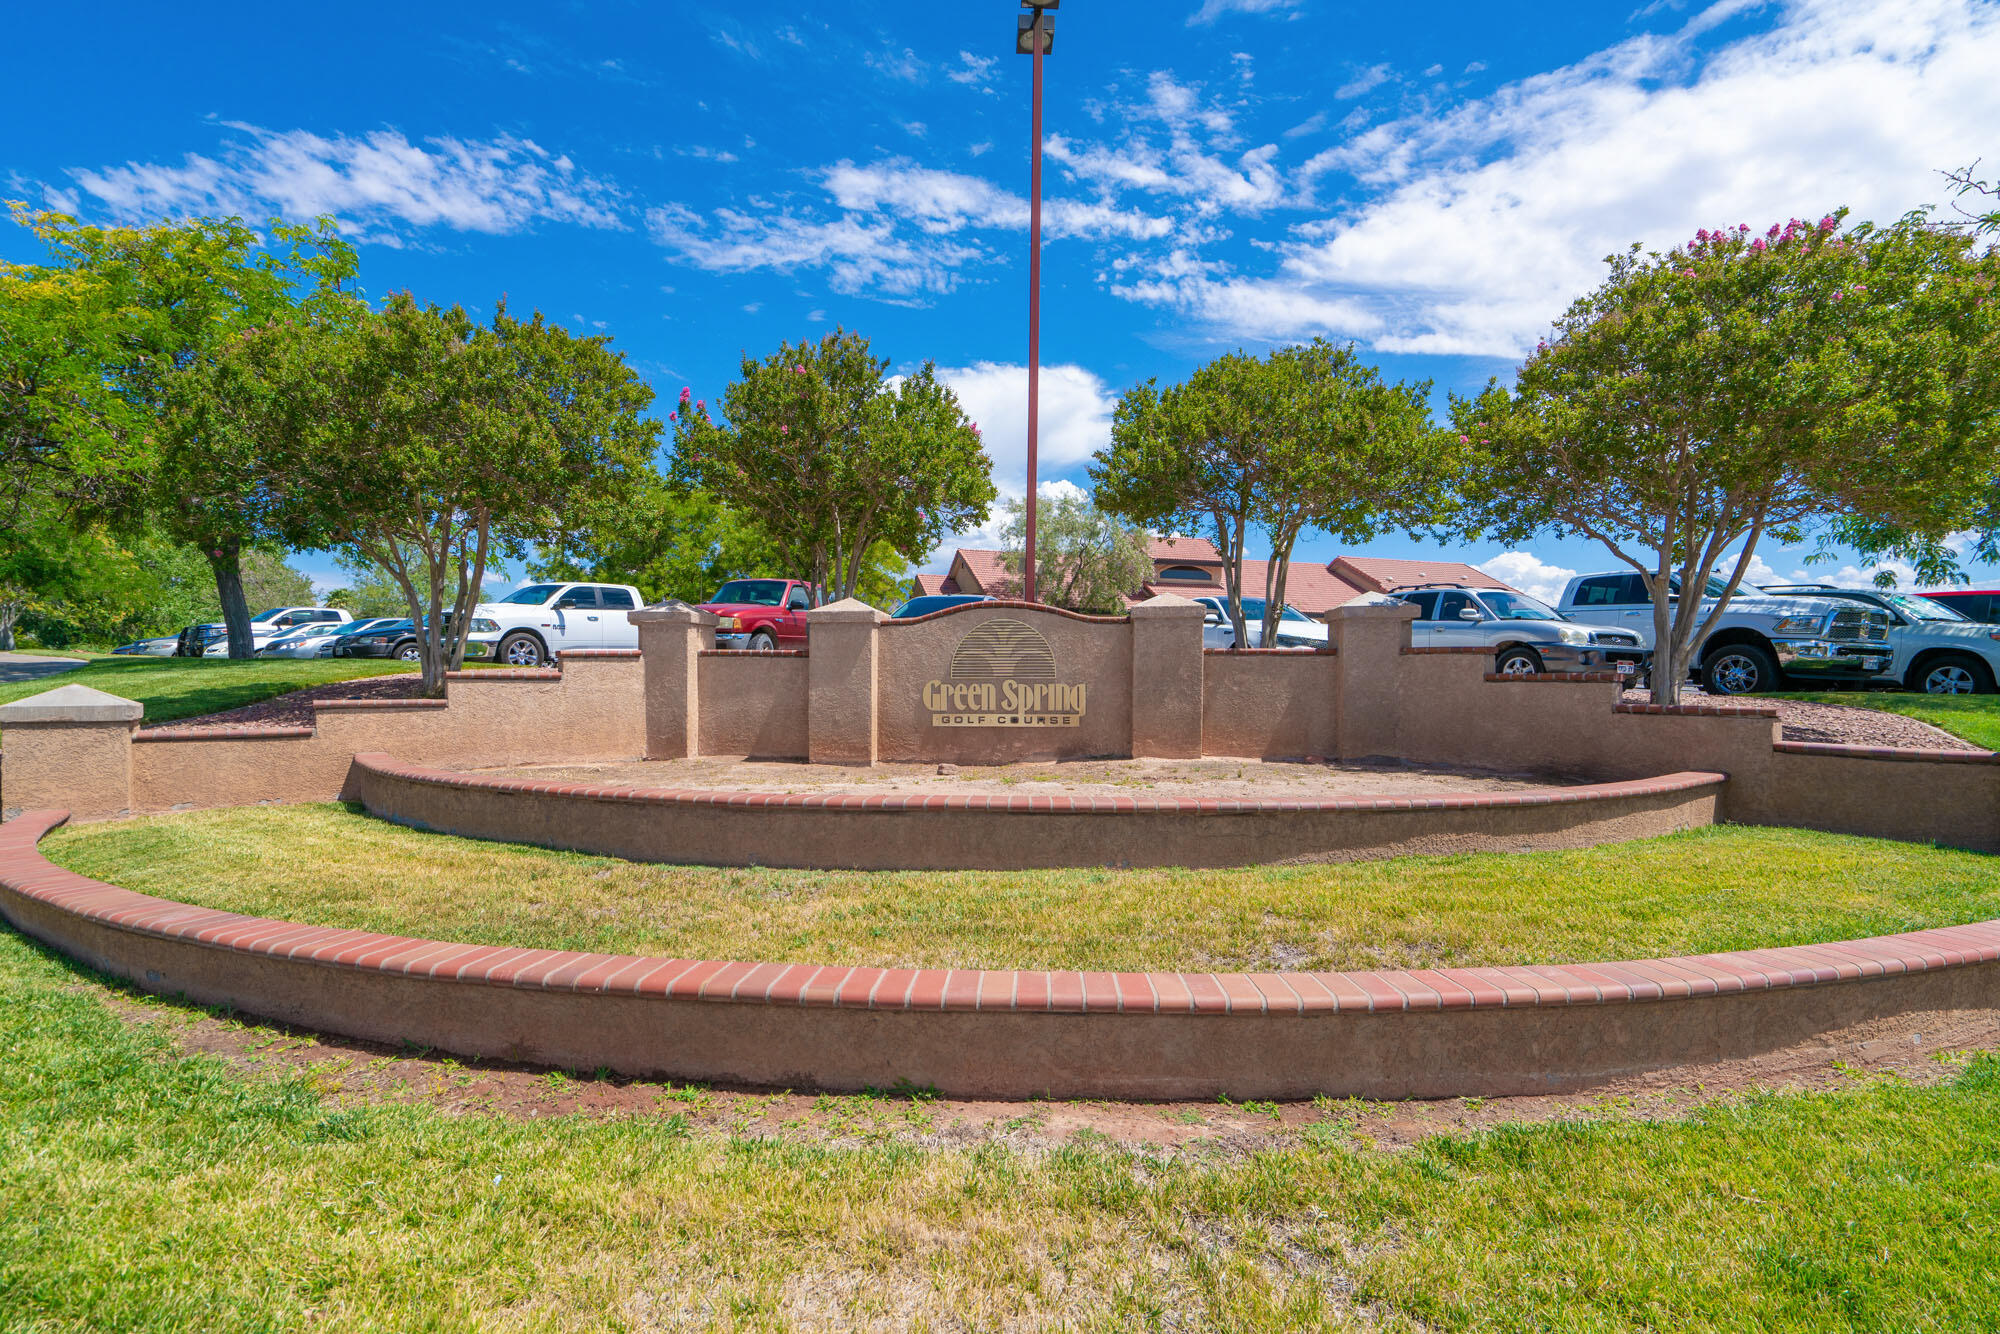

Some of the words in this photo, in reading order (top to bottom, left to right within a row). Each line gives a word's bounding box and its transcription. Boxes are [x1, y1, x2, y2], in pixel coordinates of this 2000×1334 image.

[923, 679, 997, 712] Green
[1001, 679, 1086, 717] Spring
[941, 716, 986, 725] GOLF
[997, 716, 1071, 725] COURSE
